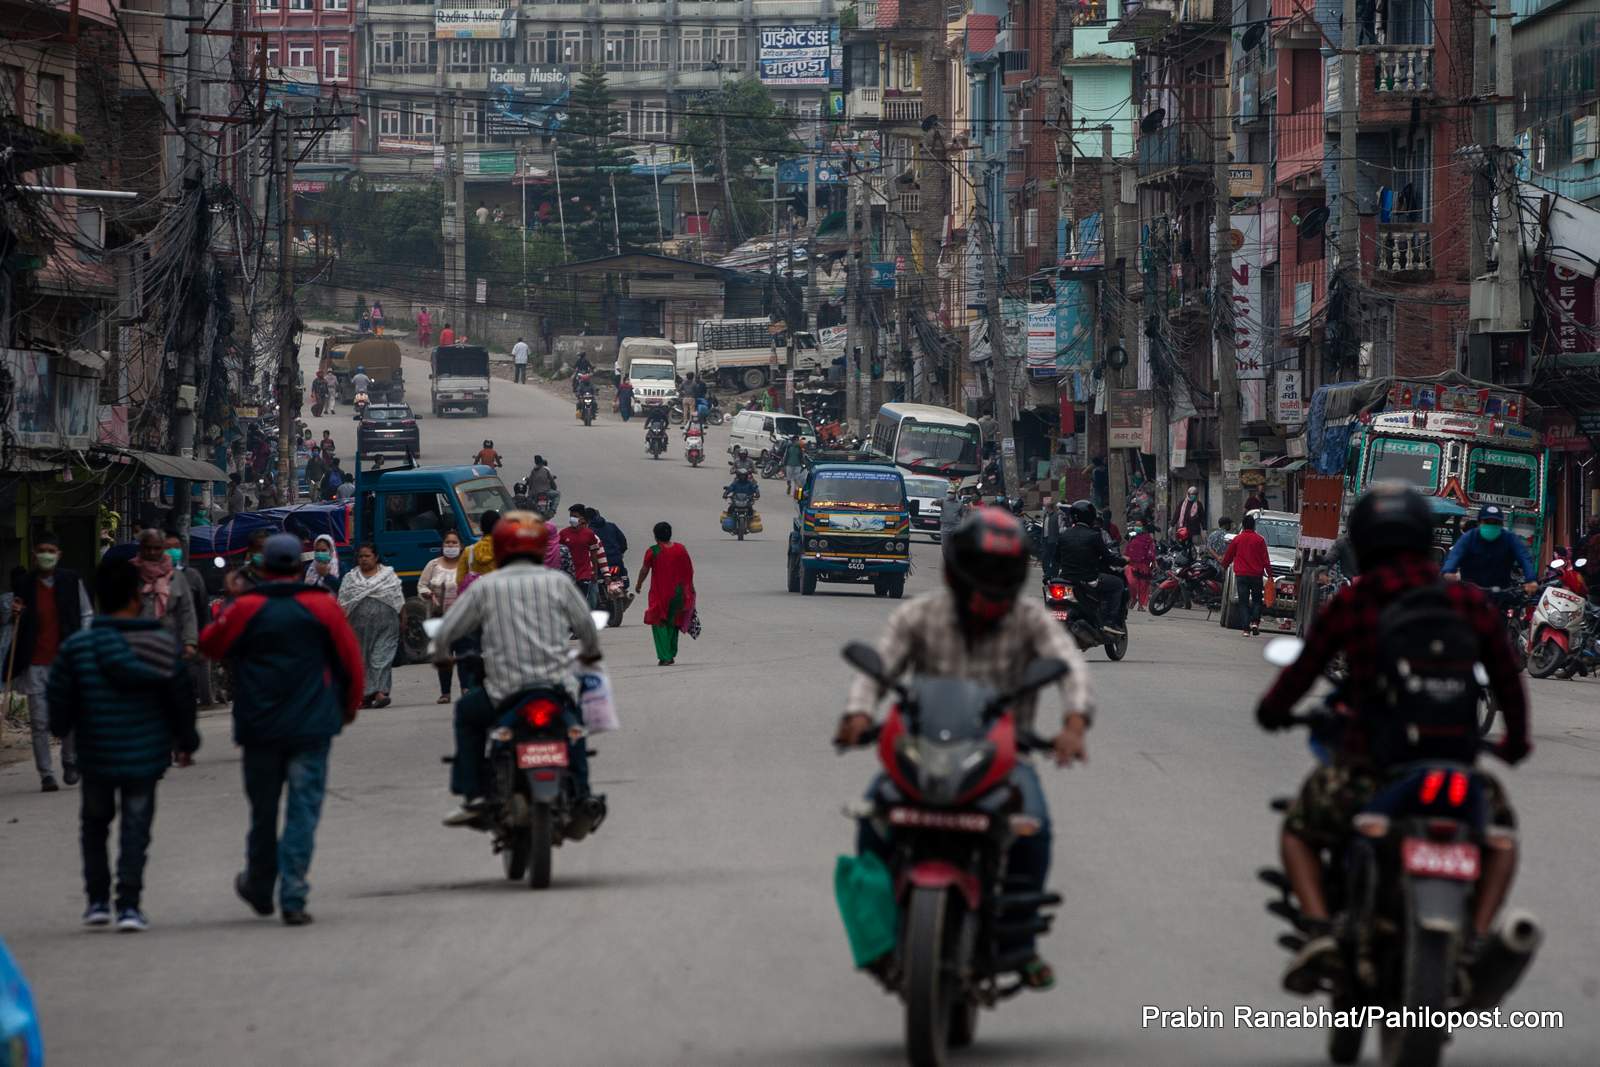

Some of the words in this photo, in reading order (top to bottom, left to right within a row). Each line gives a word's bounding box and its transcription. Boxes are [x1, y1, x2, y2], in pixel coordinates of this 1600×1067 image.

[437, 10, 469, 23] Radius
[472, 10, 501, 22] Music
[807, 31, 829, 45] SEE
[490, 67, 526, 83] Radius
[529, 67, 563, 83] Music
[1559, 286, 1577, 350] EVERE
